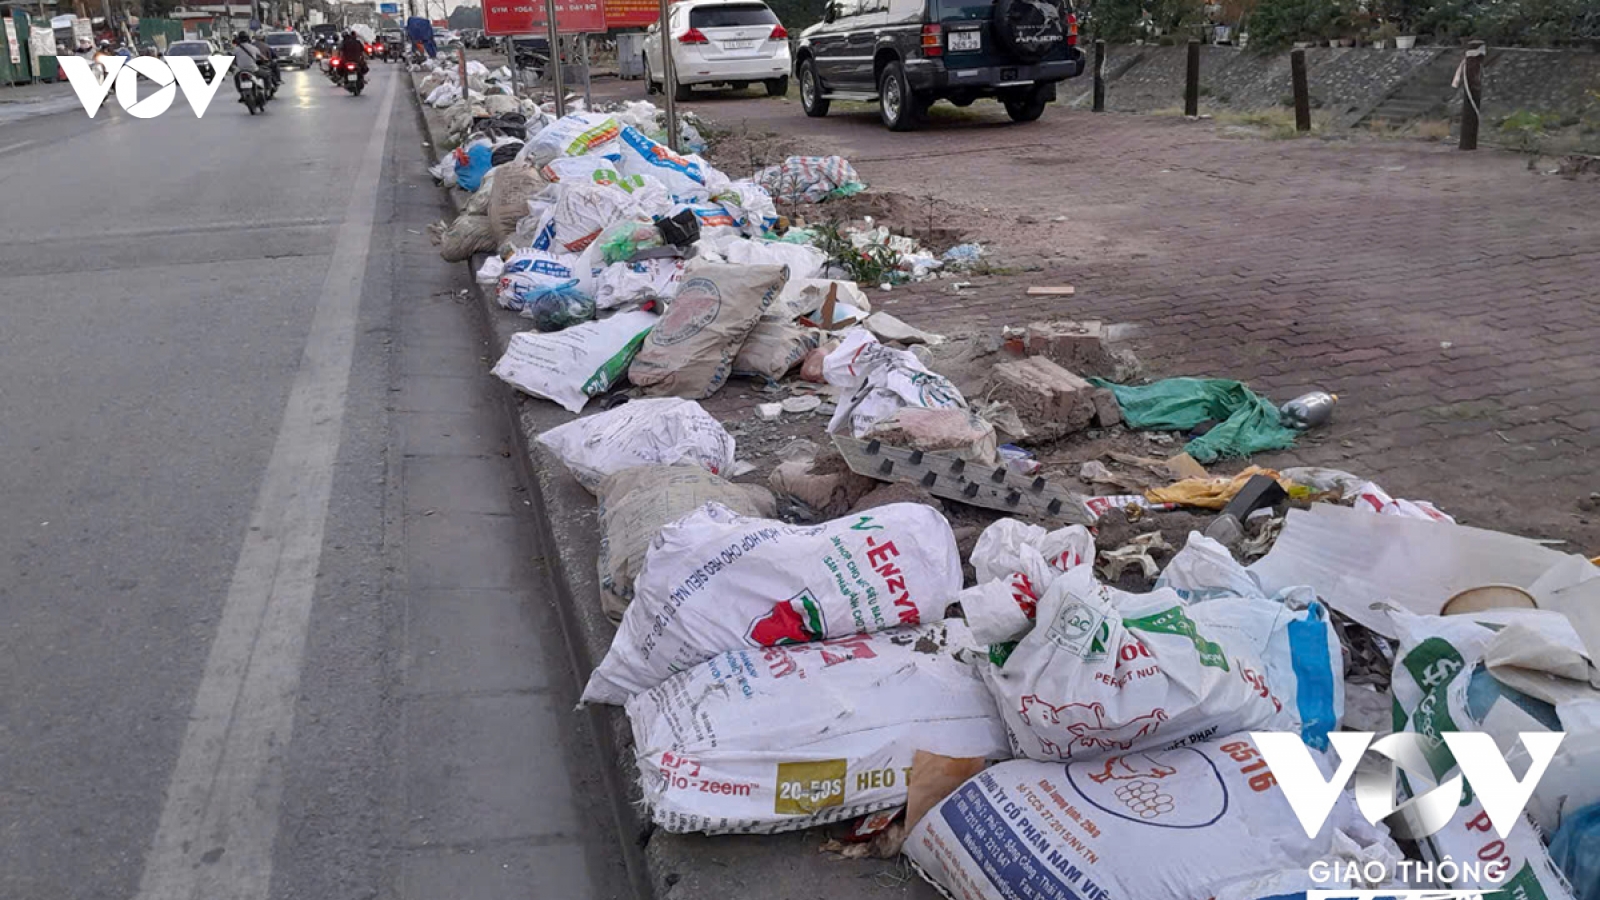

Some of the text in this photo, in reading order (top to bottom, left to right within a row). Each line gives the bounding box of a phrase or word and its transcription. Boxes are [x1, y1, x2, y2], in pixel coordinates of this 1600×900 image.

[720, 543, 742, 564] CHO
[703, 558, 726, 576] HEO
[856, 769, 895, 791] HEO
[1024, 790, 1044, 812] TCCS
[1047, 849, 1082, 883] NAM
